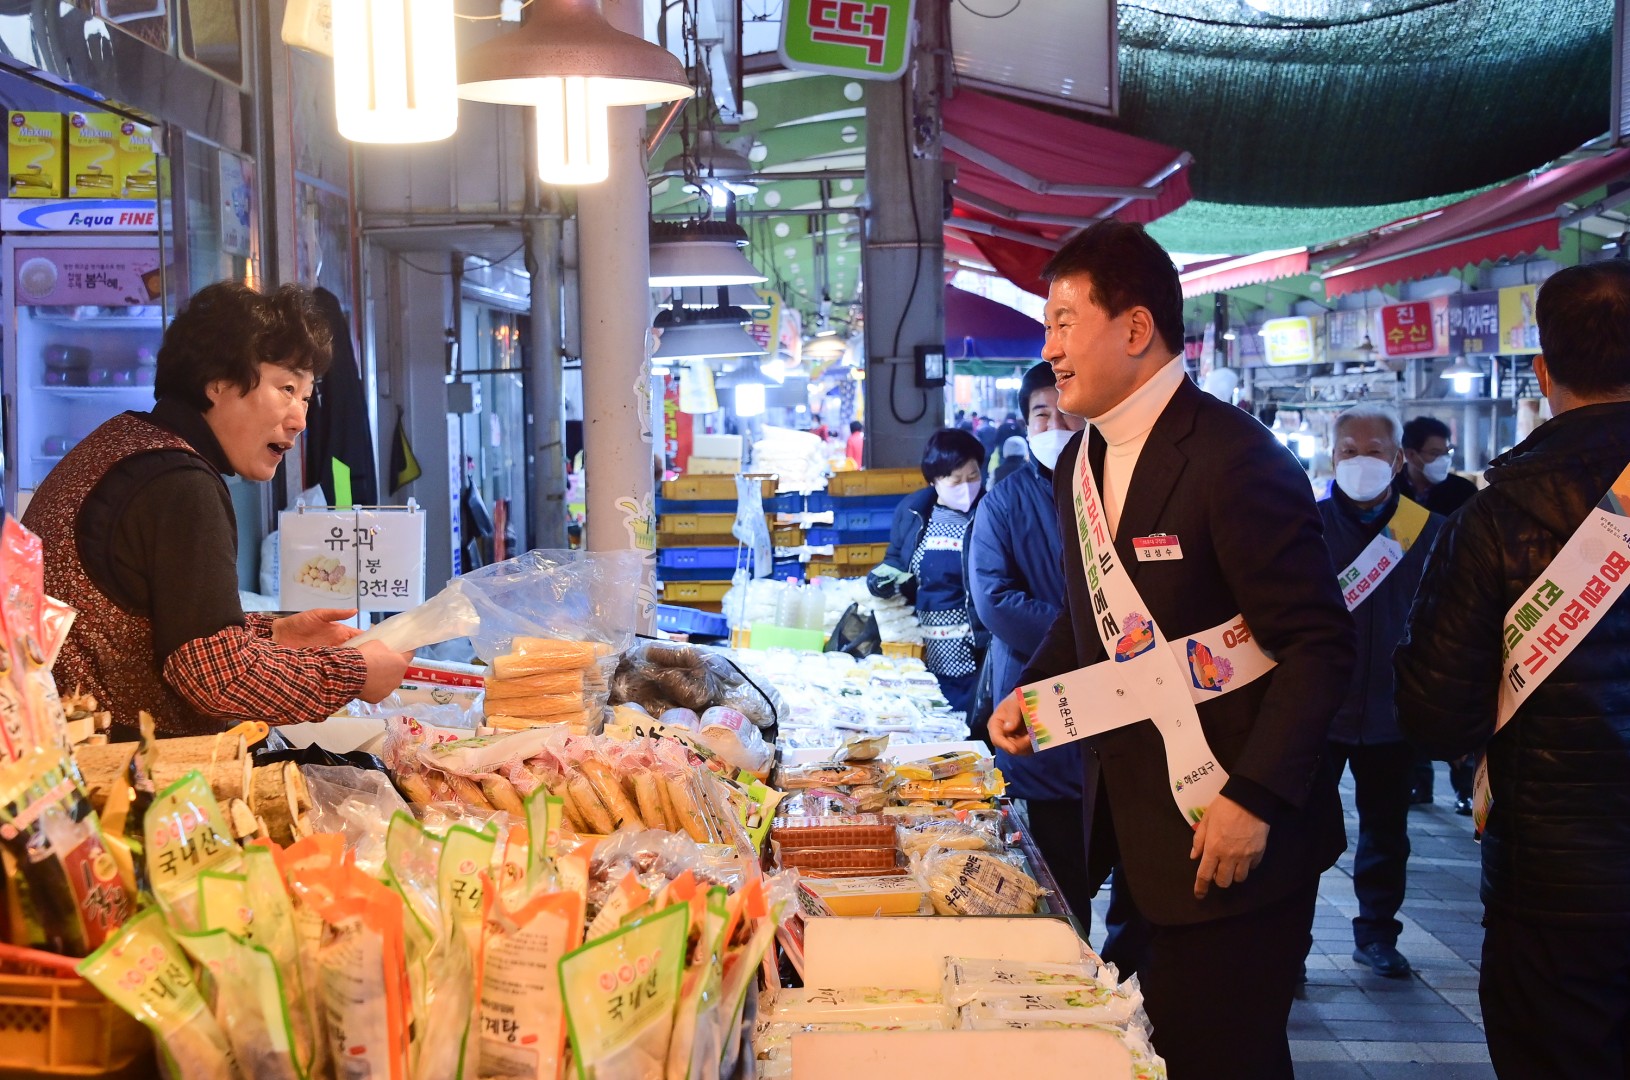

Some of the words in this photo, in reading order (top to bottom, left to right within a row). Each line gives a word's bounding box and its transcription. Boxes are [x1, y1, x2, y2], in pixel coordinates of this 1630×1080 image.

[809, 0, 889, 64] 떡
[19, 127, 53, 137] Maxim
[79, 128, 113, 138] Maxim
[68, 212, 114, 228] Aqua
[119, 212, 155, 225] FINE
[1396, 306, 1415, 325] 진
[1388, 325, 1427, 345] 수산
[324, 526, 378, 551] 유과
[360, 579, 409, 597] 3천원
[1344, 556, 1391, 607] 명절장보
[1058, 696, 1078, 738] 해운대구
[1184, 761, 1215, 785] 해운대구
[159, 828, 219, 876] 국내산
[480, 1014, 519, 1043] 계탕
